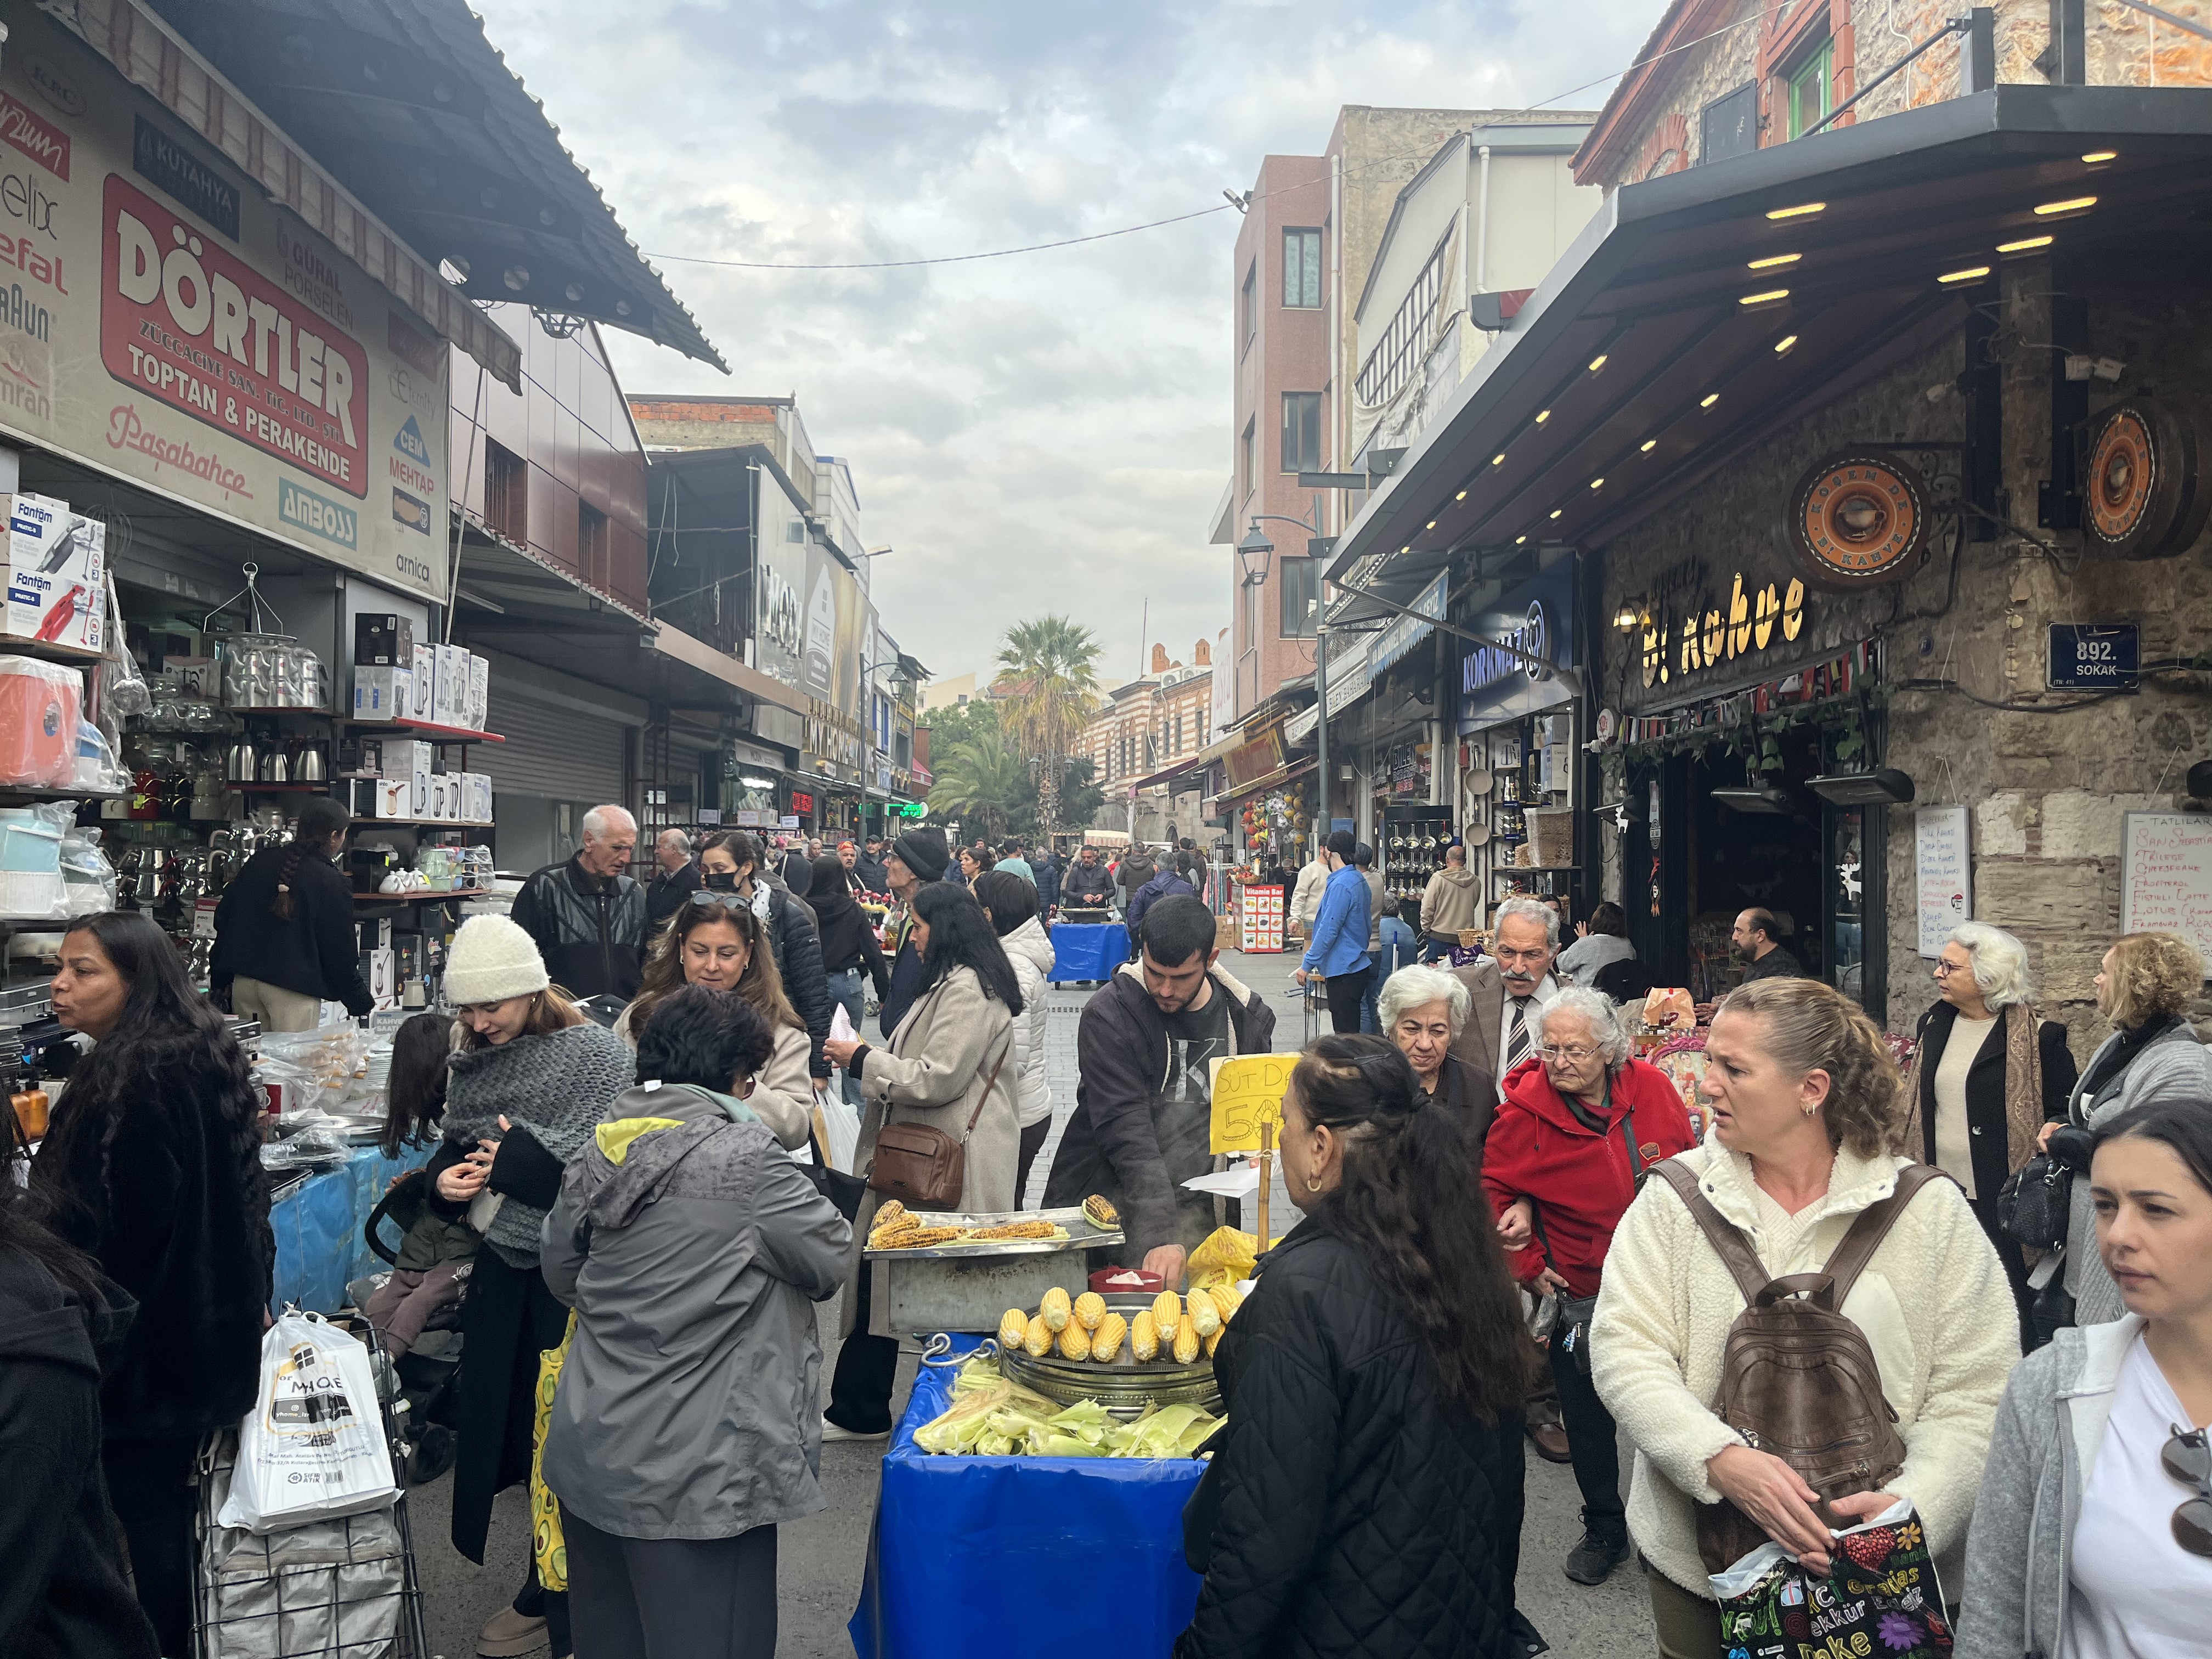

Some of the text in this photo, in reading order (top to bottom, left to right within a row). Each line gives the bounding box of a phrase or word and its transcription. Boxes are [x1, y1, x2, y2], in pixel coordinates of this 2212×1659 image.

[0, 174, 57, 240] elix
[0, 233, 69, 296] efal
[0, 283, 48, 343] RAUN
[116, 208, 358, 449] DÖRTLER
[128, 343, 351, 483] TOPTAN & PERAKENDE
[228, 369, 260, 399] SAN.
[294, 407, 319, 432] LTD.
[105, 403, 254, 500] Paşabahçe
[400, 430, 423, 459] CEM
[390, 455, 435, 496] MEHTAP
[284, 487, 354, 543] AMBOSS
[396, 554, 430, 583] arnica
[1841, 533, 1904, 566] KAHVE
[1463, 627, 1525, 695] KORKMAZ
[2076, 642, 2117, 661] 892.
[2076, 665, 2117, 676] SOKAK
[1218, 1066, 1257, 1093] SÜT
[1222, 1099, 1279, 1142] 50
[1810, 1600, 1866, 1638] ekkür
